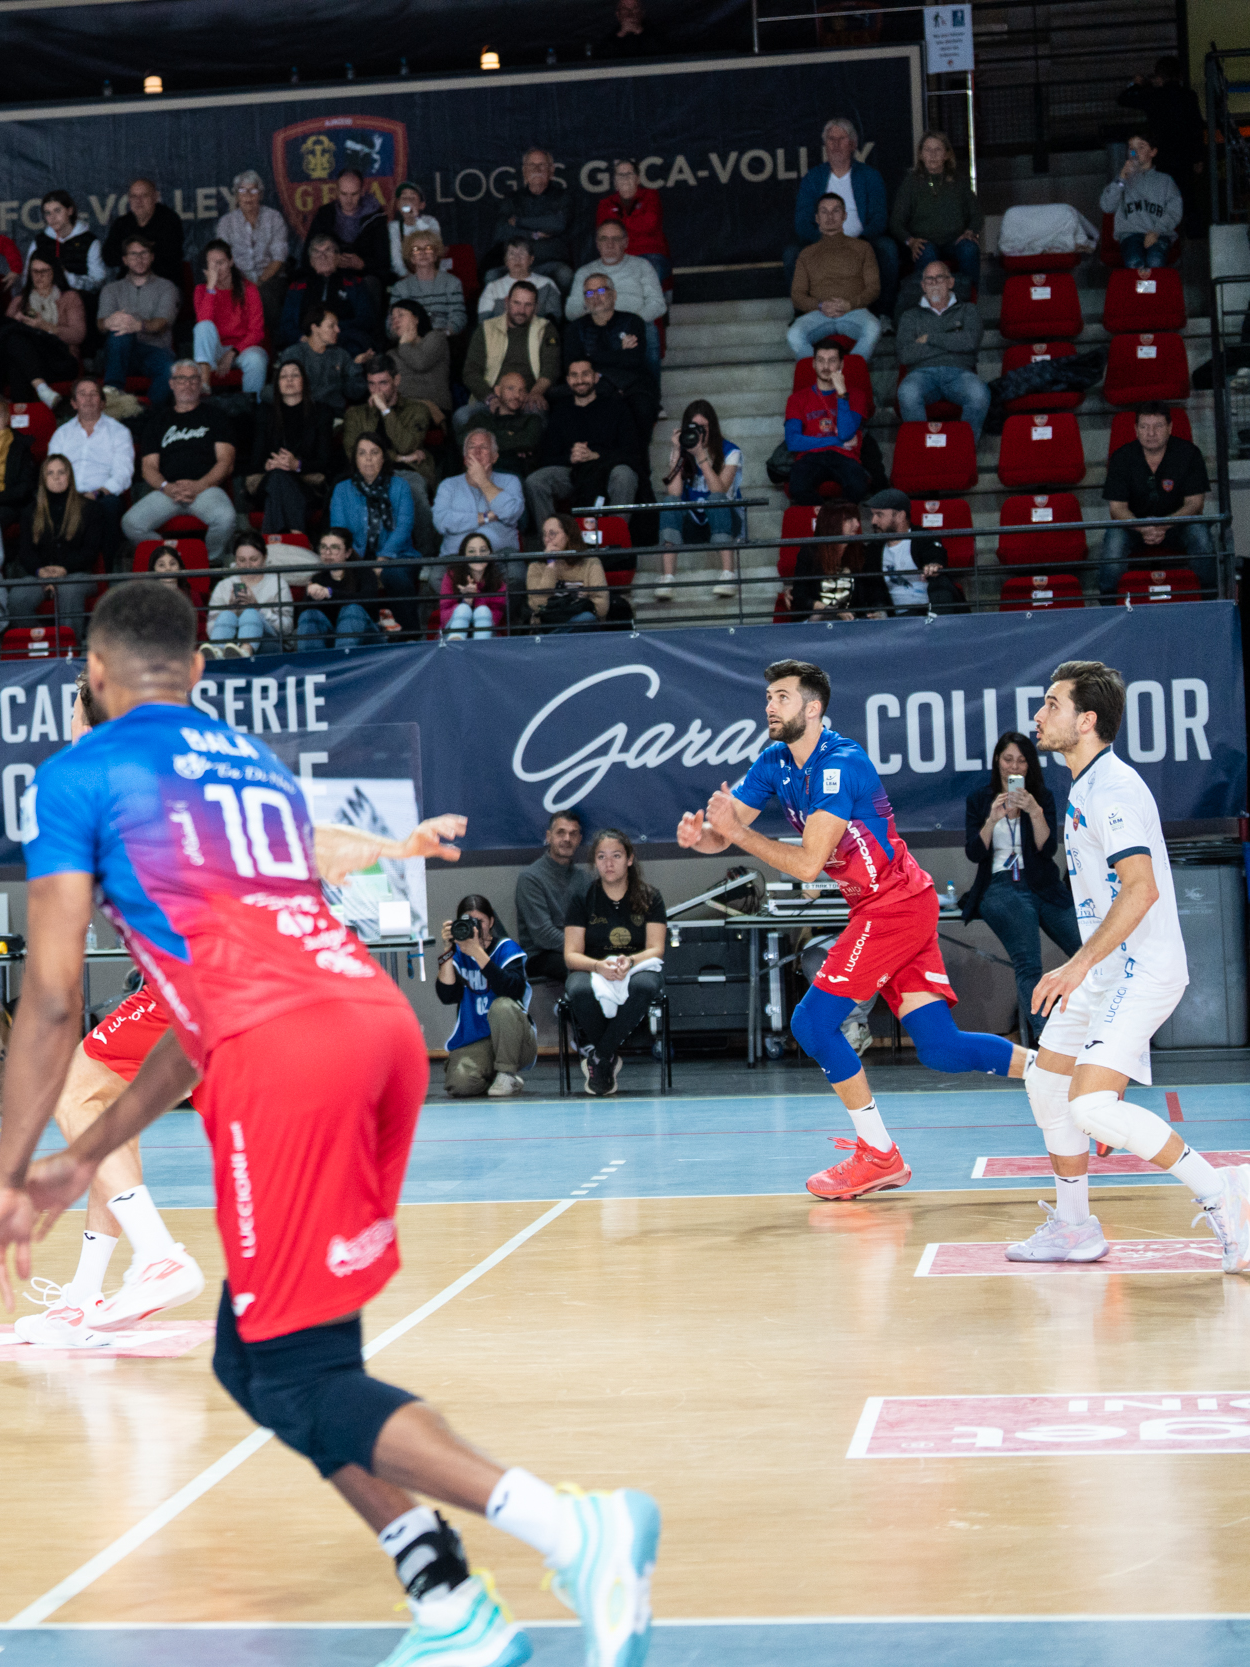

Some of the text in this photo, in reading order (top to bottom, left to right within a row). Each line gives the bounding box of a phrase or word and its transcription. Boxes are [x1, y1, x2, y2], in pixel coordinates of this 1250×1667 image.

[436, 142, 875, 203] LOGS GCA-VOLLY
[512, 663, 1212, 813] Gara COLLEOR
[204, 783, 309, 881] 10
[1109, 817, 1123, 826] LBM
[231, 1152, 257, 1259] LUCCIONI
